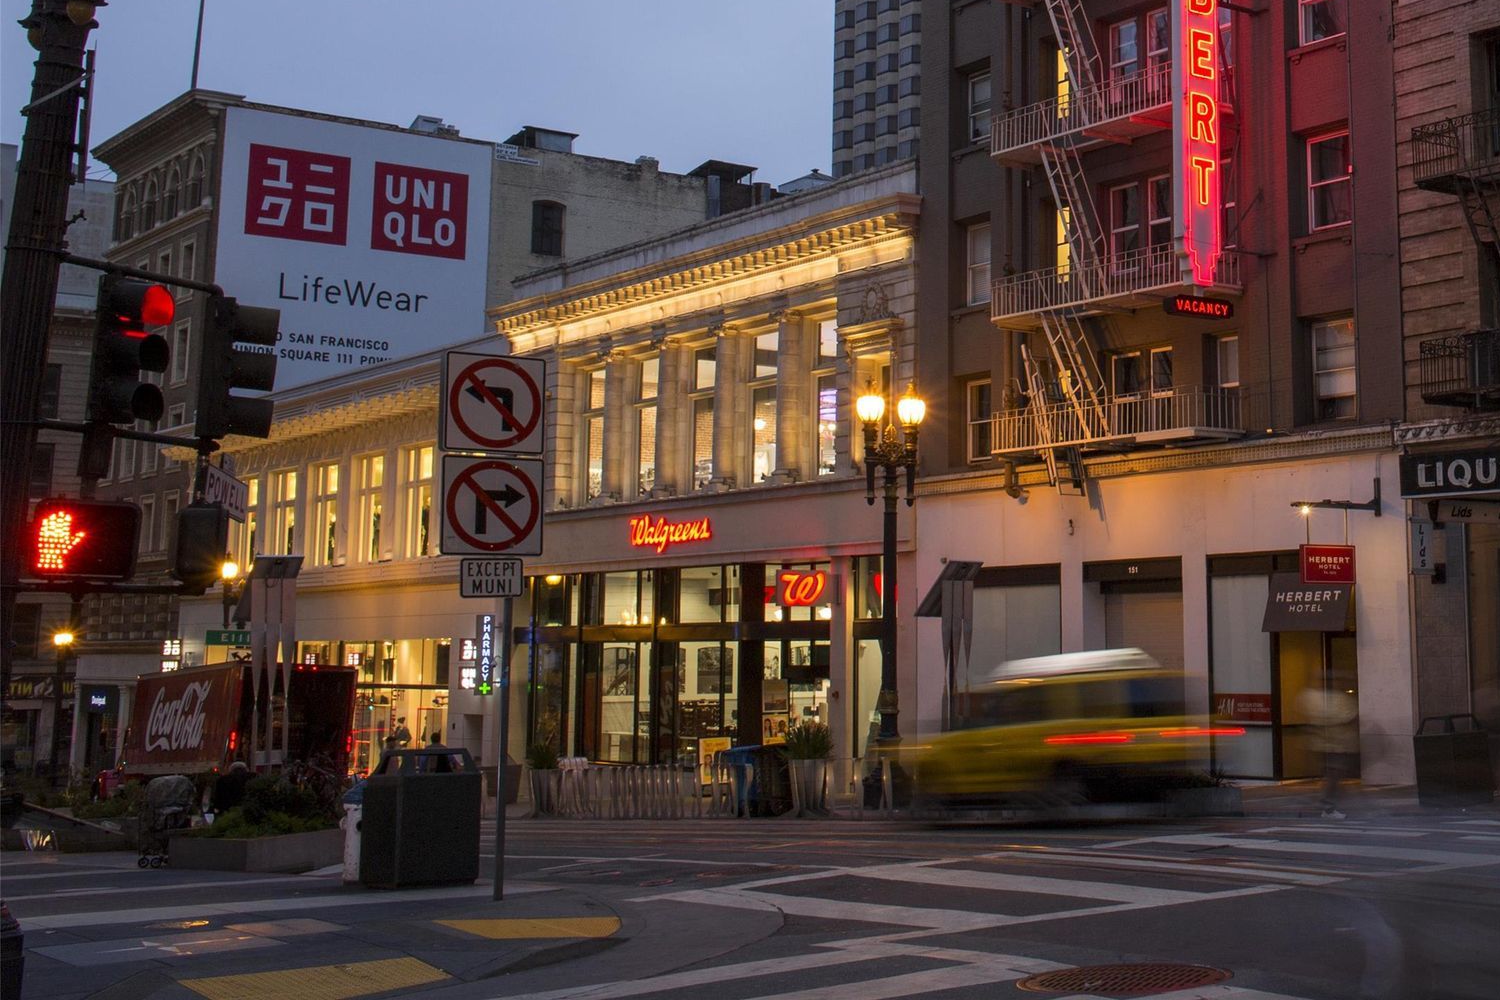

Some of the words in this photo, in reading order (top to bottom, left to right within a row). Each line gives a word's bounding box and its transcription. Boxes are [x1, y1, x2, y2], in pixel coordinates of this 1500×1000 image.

[262, 157, 335, 196] ユニ
[256, 195, 334, 233] クロ
[278, 272, 428, 313] LifeWear
[1176, 299, 1228, 316] VACANCY
[288, 333, 314, 345] SAN
[320, 336, 389, 351] FRANCISCO
[280, 349, 330, 362] SQUARE
[337, 354, 353, 364] 111
[209, 473, 245, 513] POWELL
[1451, 505, 1472, 518] Lids
[630, 514, 711, 552] Walgreens
[1417, 524, 1427, 568] Lids
[467, 562, 517, 577] EXCEPT
[472, 579, 512, 594] MUNI
[1276, 590, 1341, 603] HERBERT
[1289, 604, 1323, 613] HOTEL
[481, 616, 491, 681] PHARMACY
